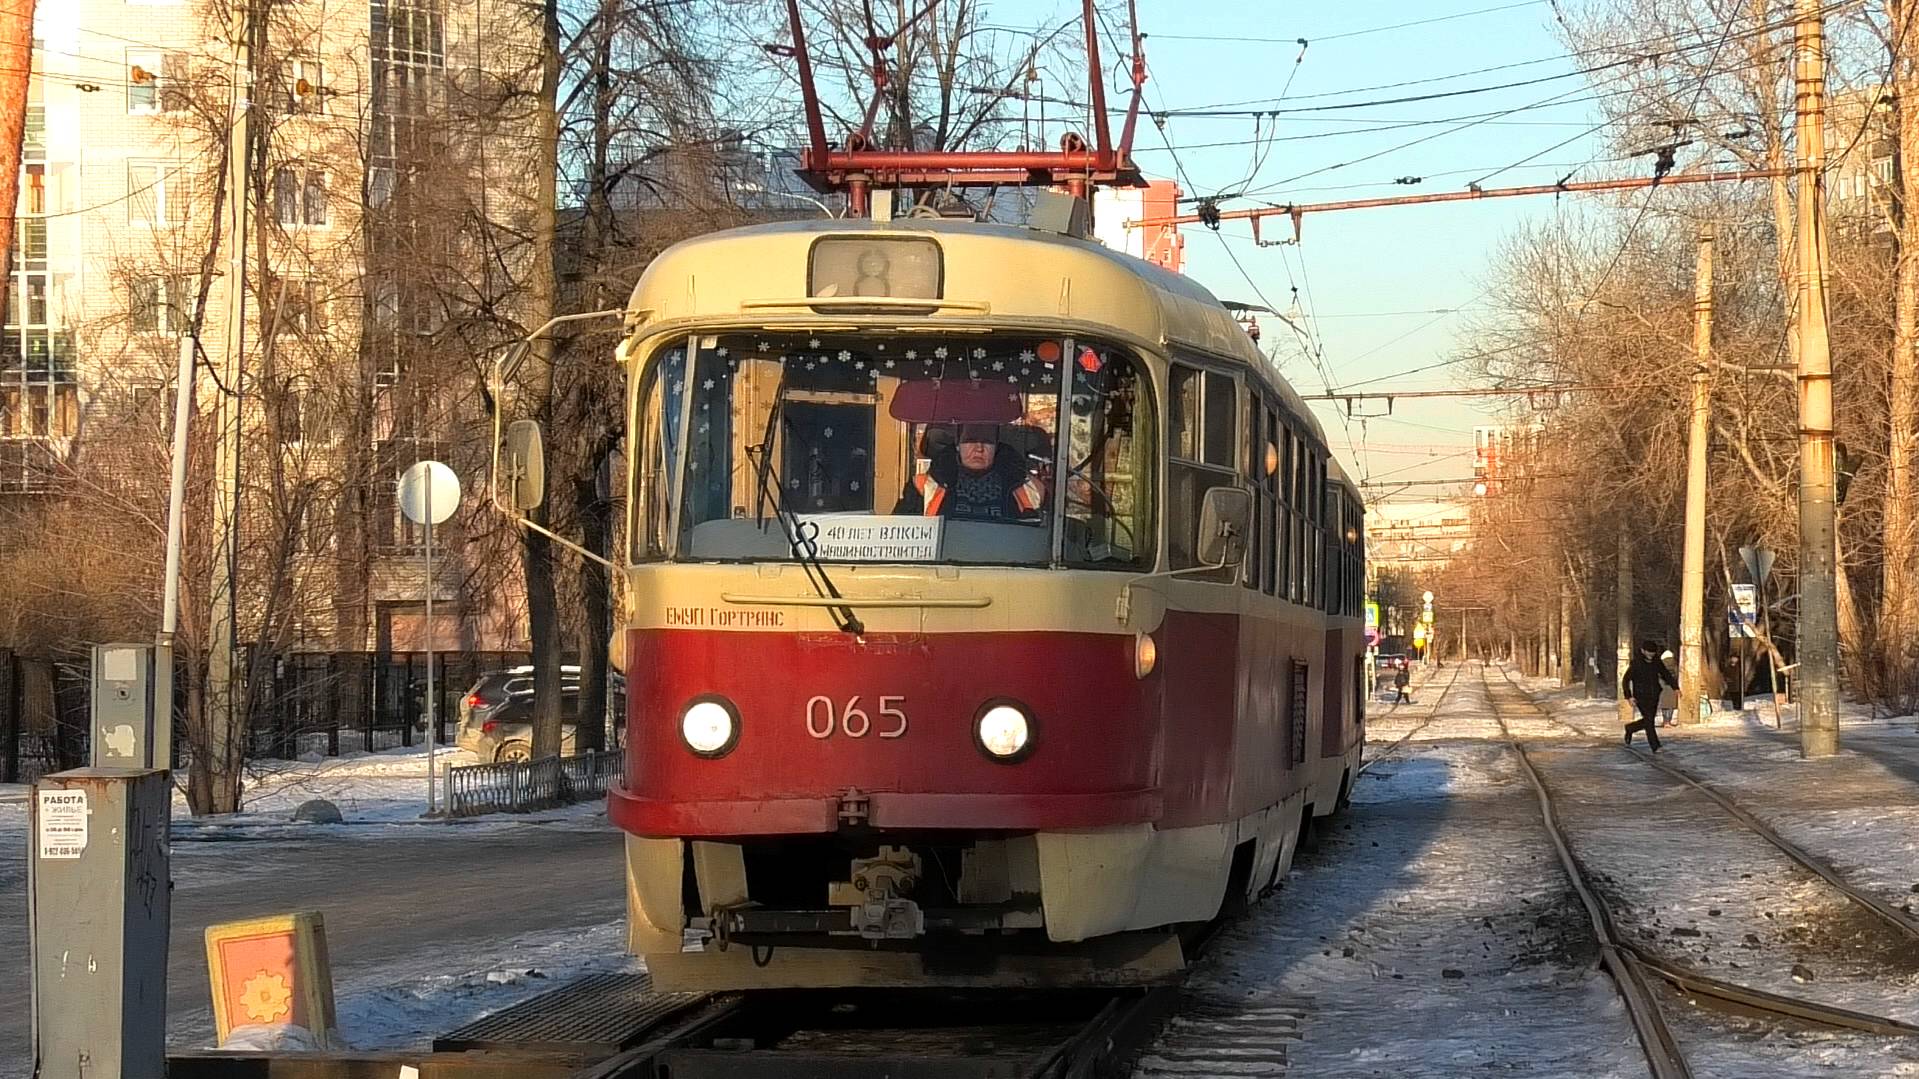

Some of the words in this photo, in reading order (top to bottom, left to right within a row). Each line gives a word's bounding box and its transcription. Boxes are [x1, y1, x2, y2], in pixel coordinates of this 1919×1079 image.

[853, 247, 891, 297] 8
[827, 526, 845, 540] 40
[847, 527, 873, 540] ЛЕТ
[880, 526, 932, 540] ВЛКСМ
[666, 607, 704, 625] ЕМУП
[806, 695, 907, 738] 065
[44, 796, 83, 804] РАБОТА
